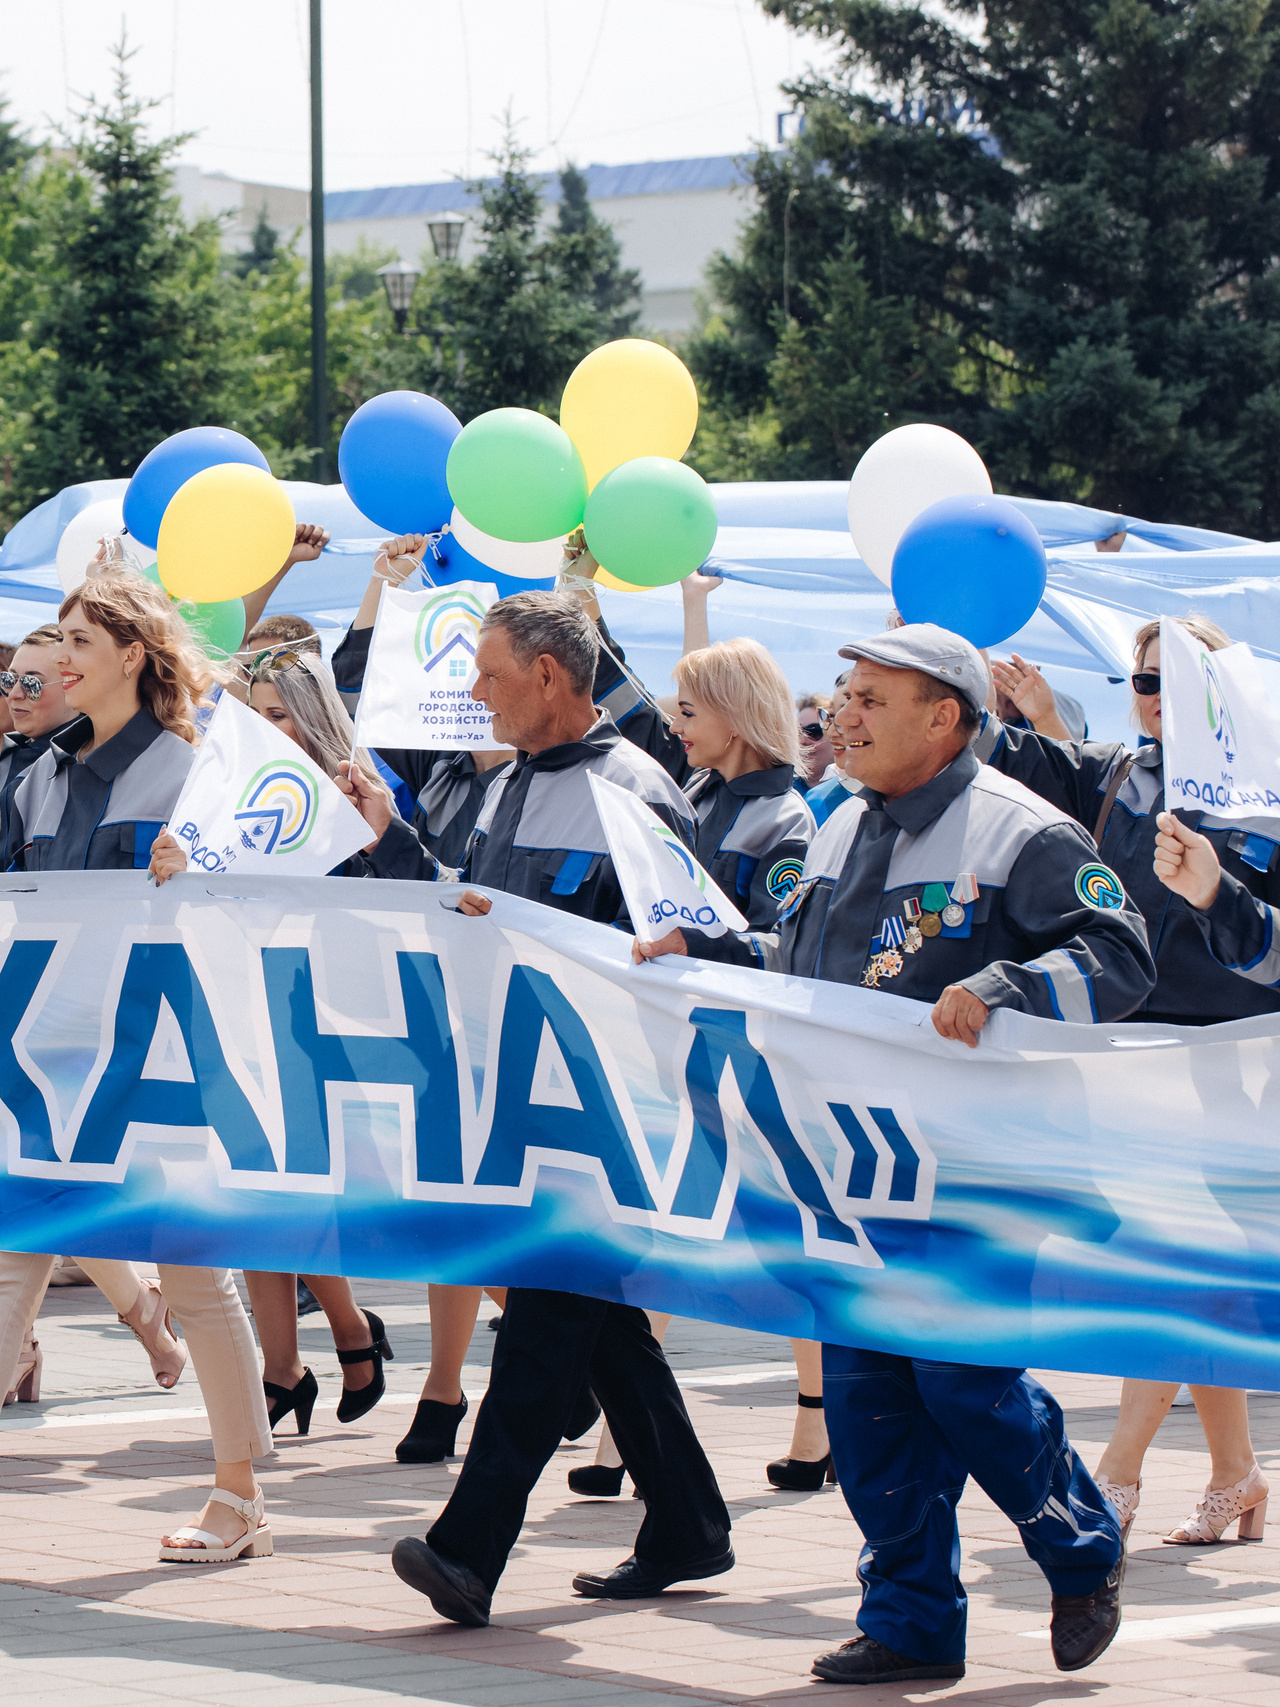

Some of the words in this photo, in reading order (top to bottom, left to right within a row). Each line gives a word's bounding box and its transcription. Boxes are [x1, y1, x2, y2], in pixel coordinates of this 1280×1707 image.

[430, 690, 472, 699] КОМИТ
[418, 703, 488, 713] ГОРОДСКО
[440, 732, 484, 741] Улан-Удэ
[647, 899, 721, 925] «ВОДО
